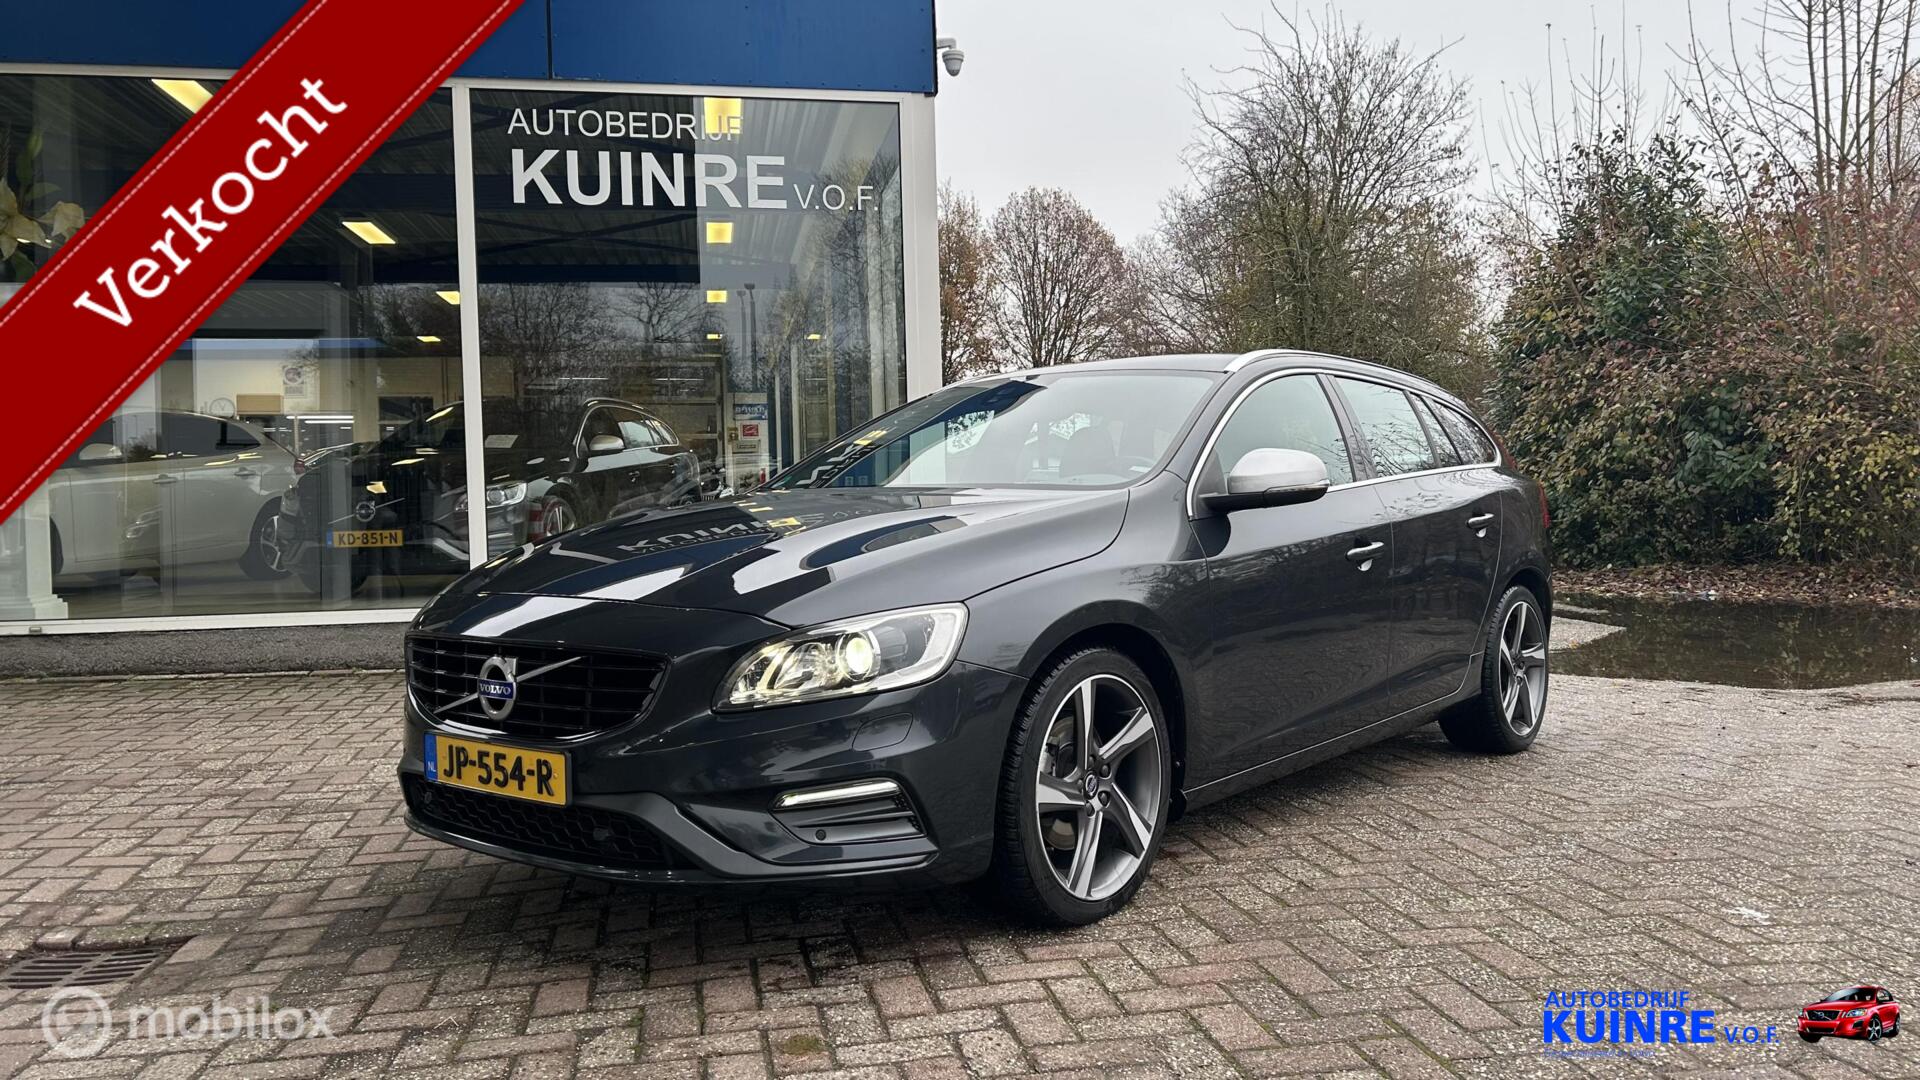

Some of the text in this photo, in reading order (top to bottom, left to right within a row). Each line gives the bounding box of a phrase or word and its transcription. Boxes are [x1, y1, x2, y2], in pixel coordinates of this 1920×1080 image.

[507, 108, 744, 141] AUTOBEDRIJF
[511, 148, 879, 212] KUINRE V.O.F.
[338, 531, 399, 546] KD-851-N
[479, 683, 511, 695] VOLVO
[427, 760, 436, 772] NL
[443, 744, 555, 797] JP-554-R
